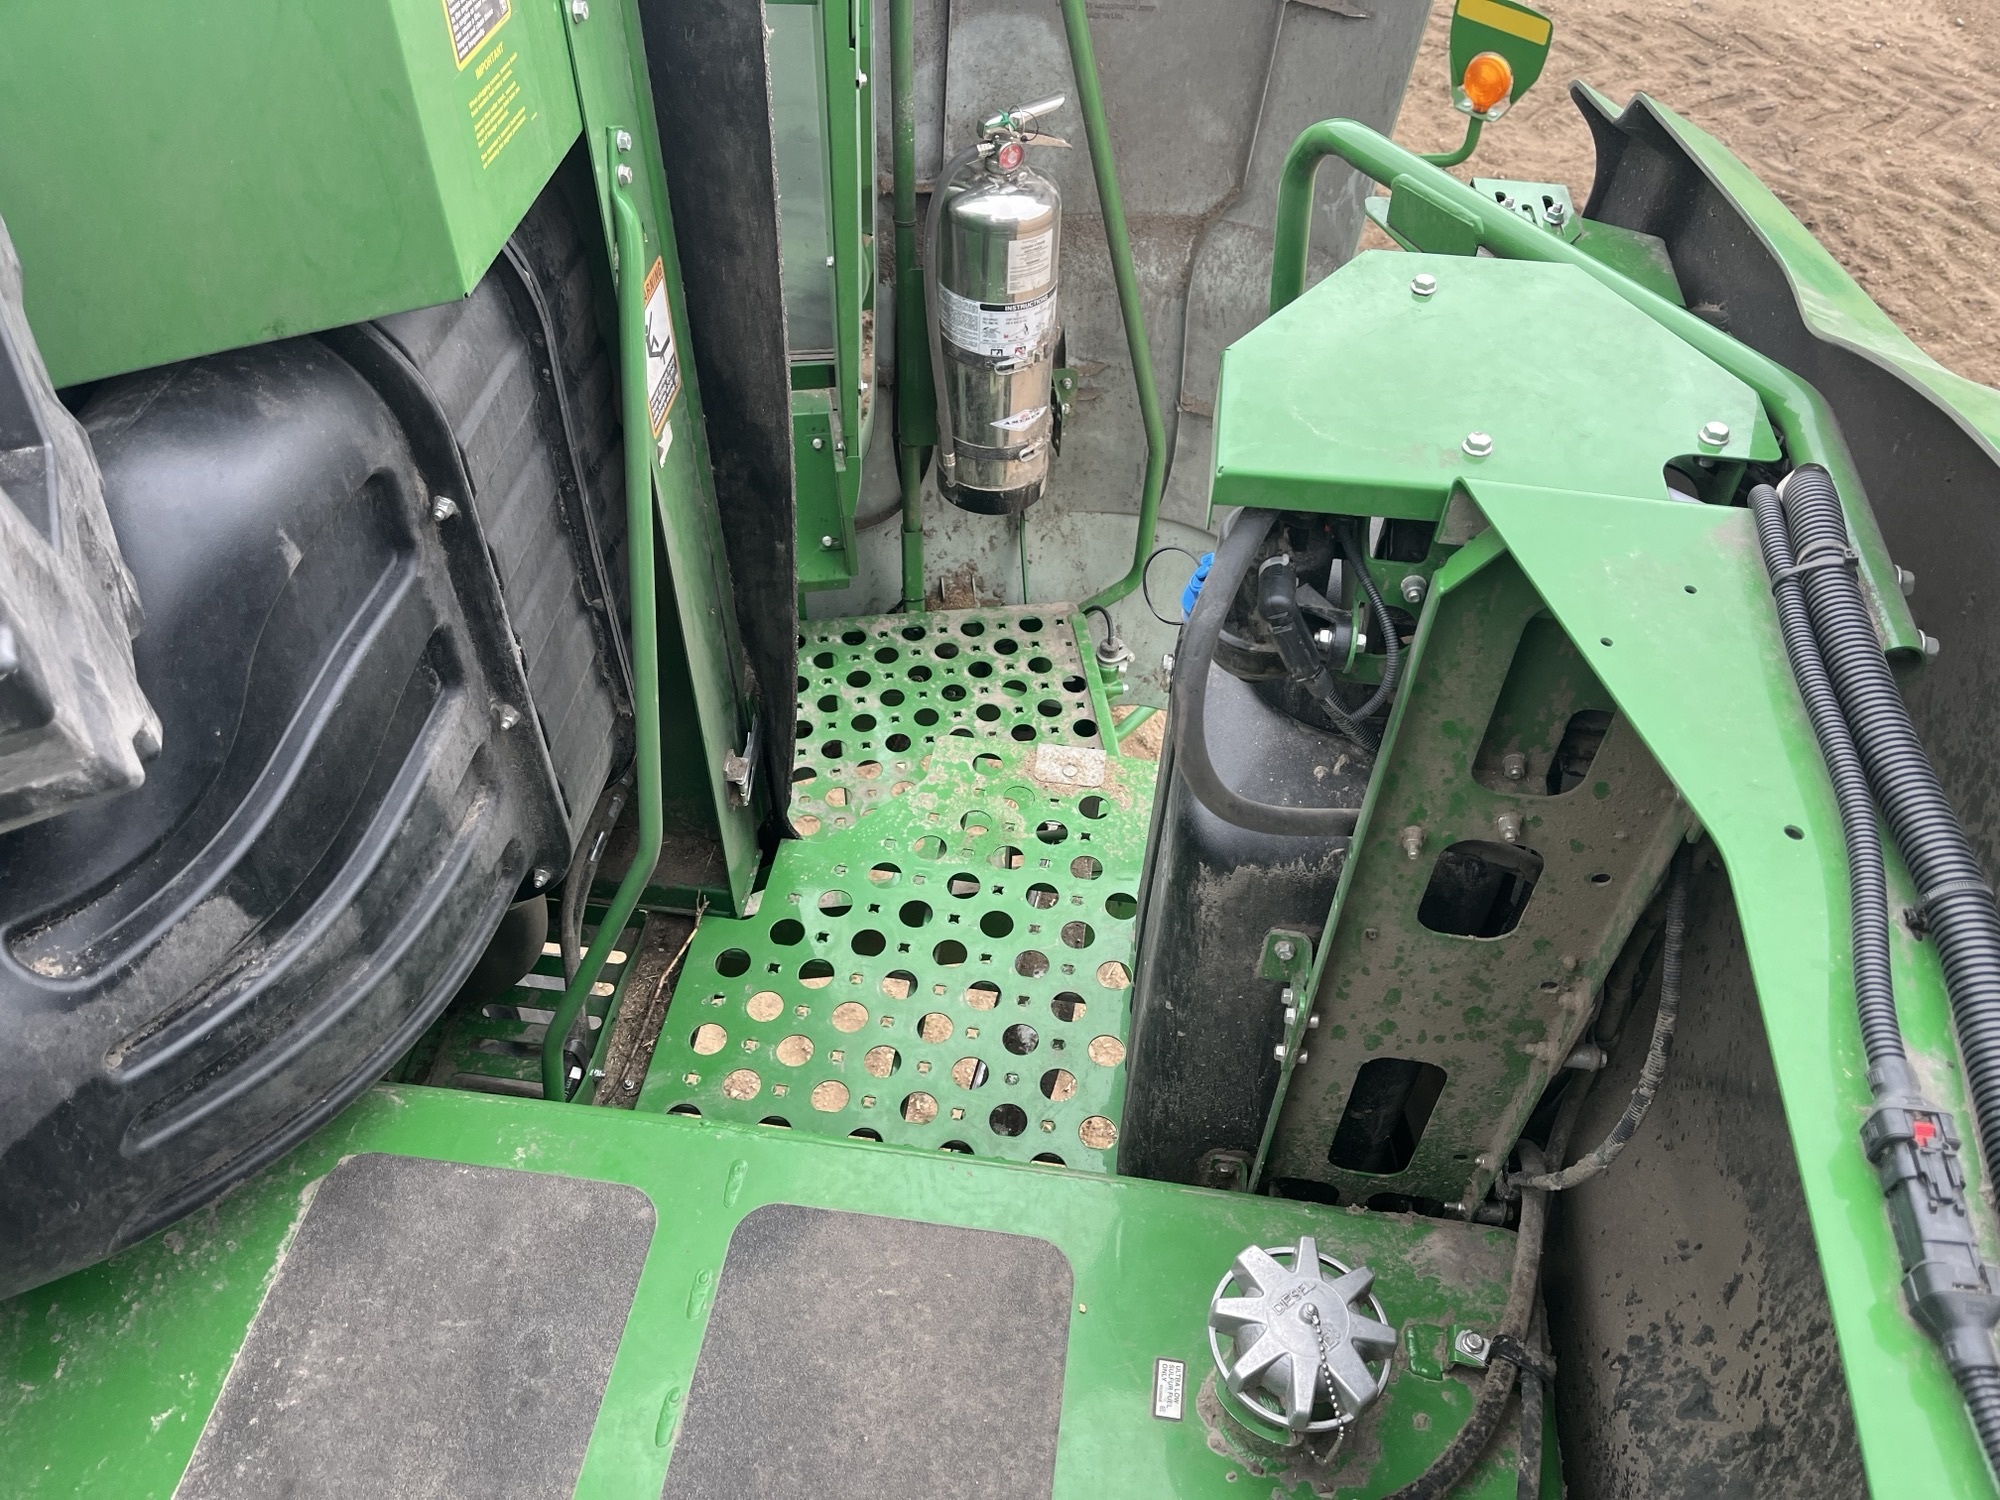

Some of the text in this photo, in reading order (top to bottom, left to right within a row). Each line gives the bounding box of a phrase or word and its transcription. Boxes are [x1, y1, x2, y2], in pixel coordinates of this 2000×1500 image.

[475, 41, 503, 80] IMPORTANT
[645, 261, 662, 301] RNING
[1004, 295, 1049, 312] INSTRUCTIONS
[1271, 1282, 1317, 1316] DIESEL
[1166, 1364, 1175, 1409] SULFUR FUEL
[1173, 1365, 1182, 1404] ULTRA LOW
